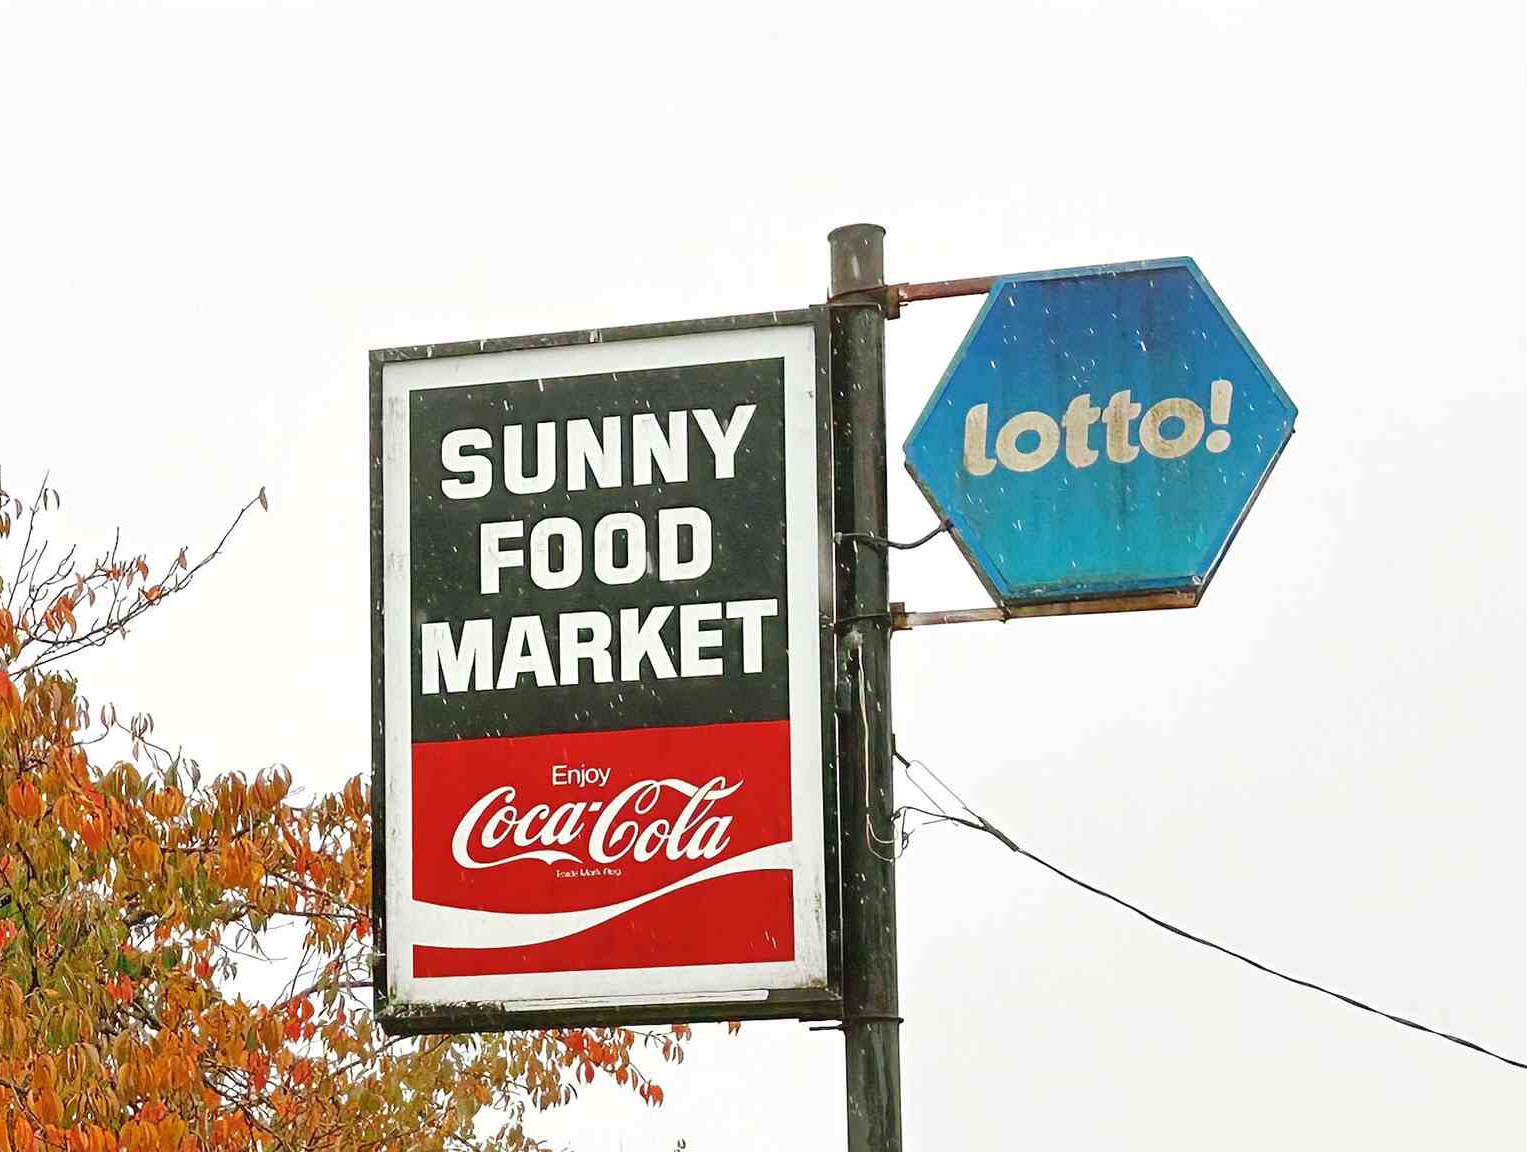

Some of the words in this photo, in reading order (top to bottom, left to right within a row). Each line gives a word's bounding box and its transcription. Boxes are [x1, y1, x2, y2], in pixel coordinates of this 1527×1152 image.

[441, 404, 757, 500] SUNNY
[963, 379, 1233, 476] lotto!
[480, 506, 713, 594] FOOD
[420, 598, 778, 695] MARKET
[451, 776, 745, 869] Coca-Cola
[552, 763, 611, 788] Enjoy
